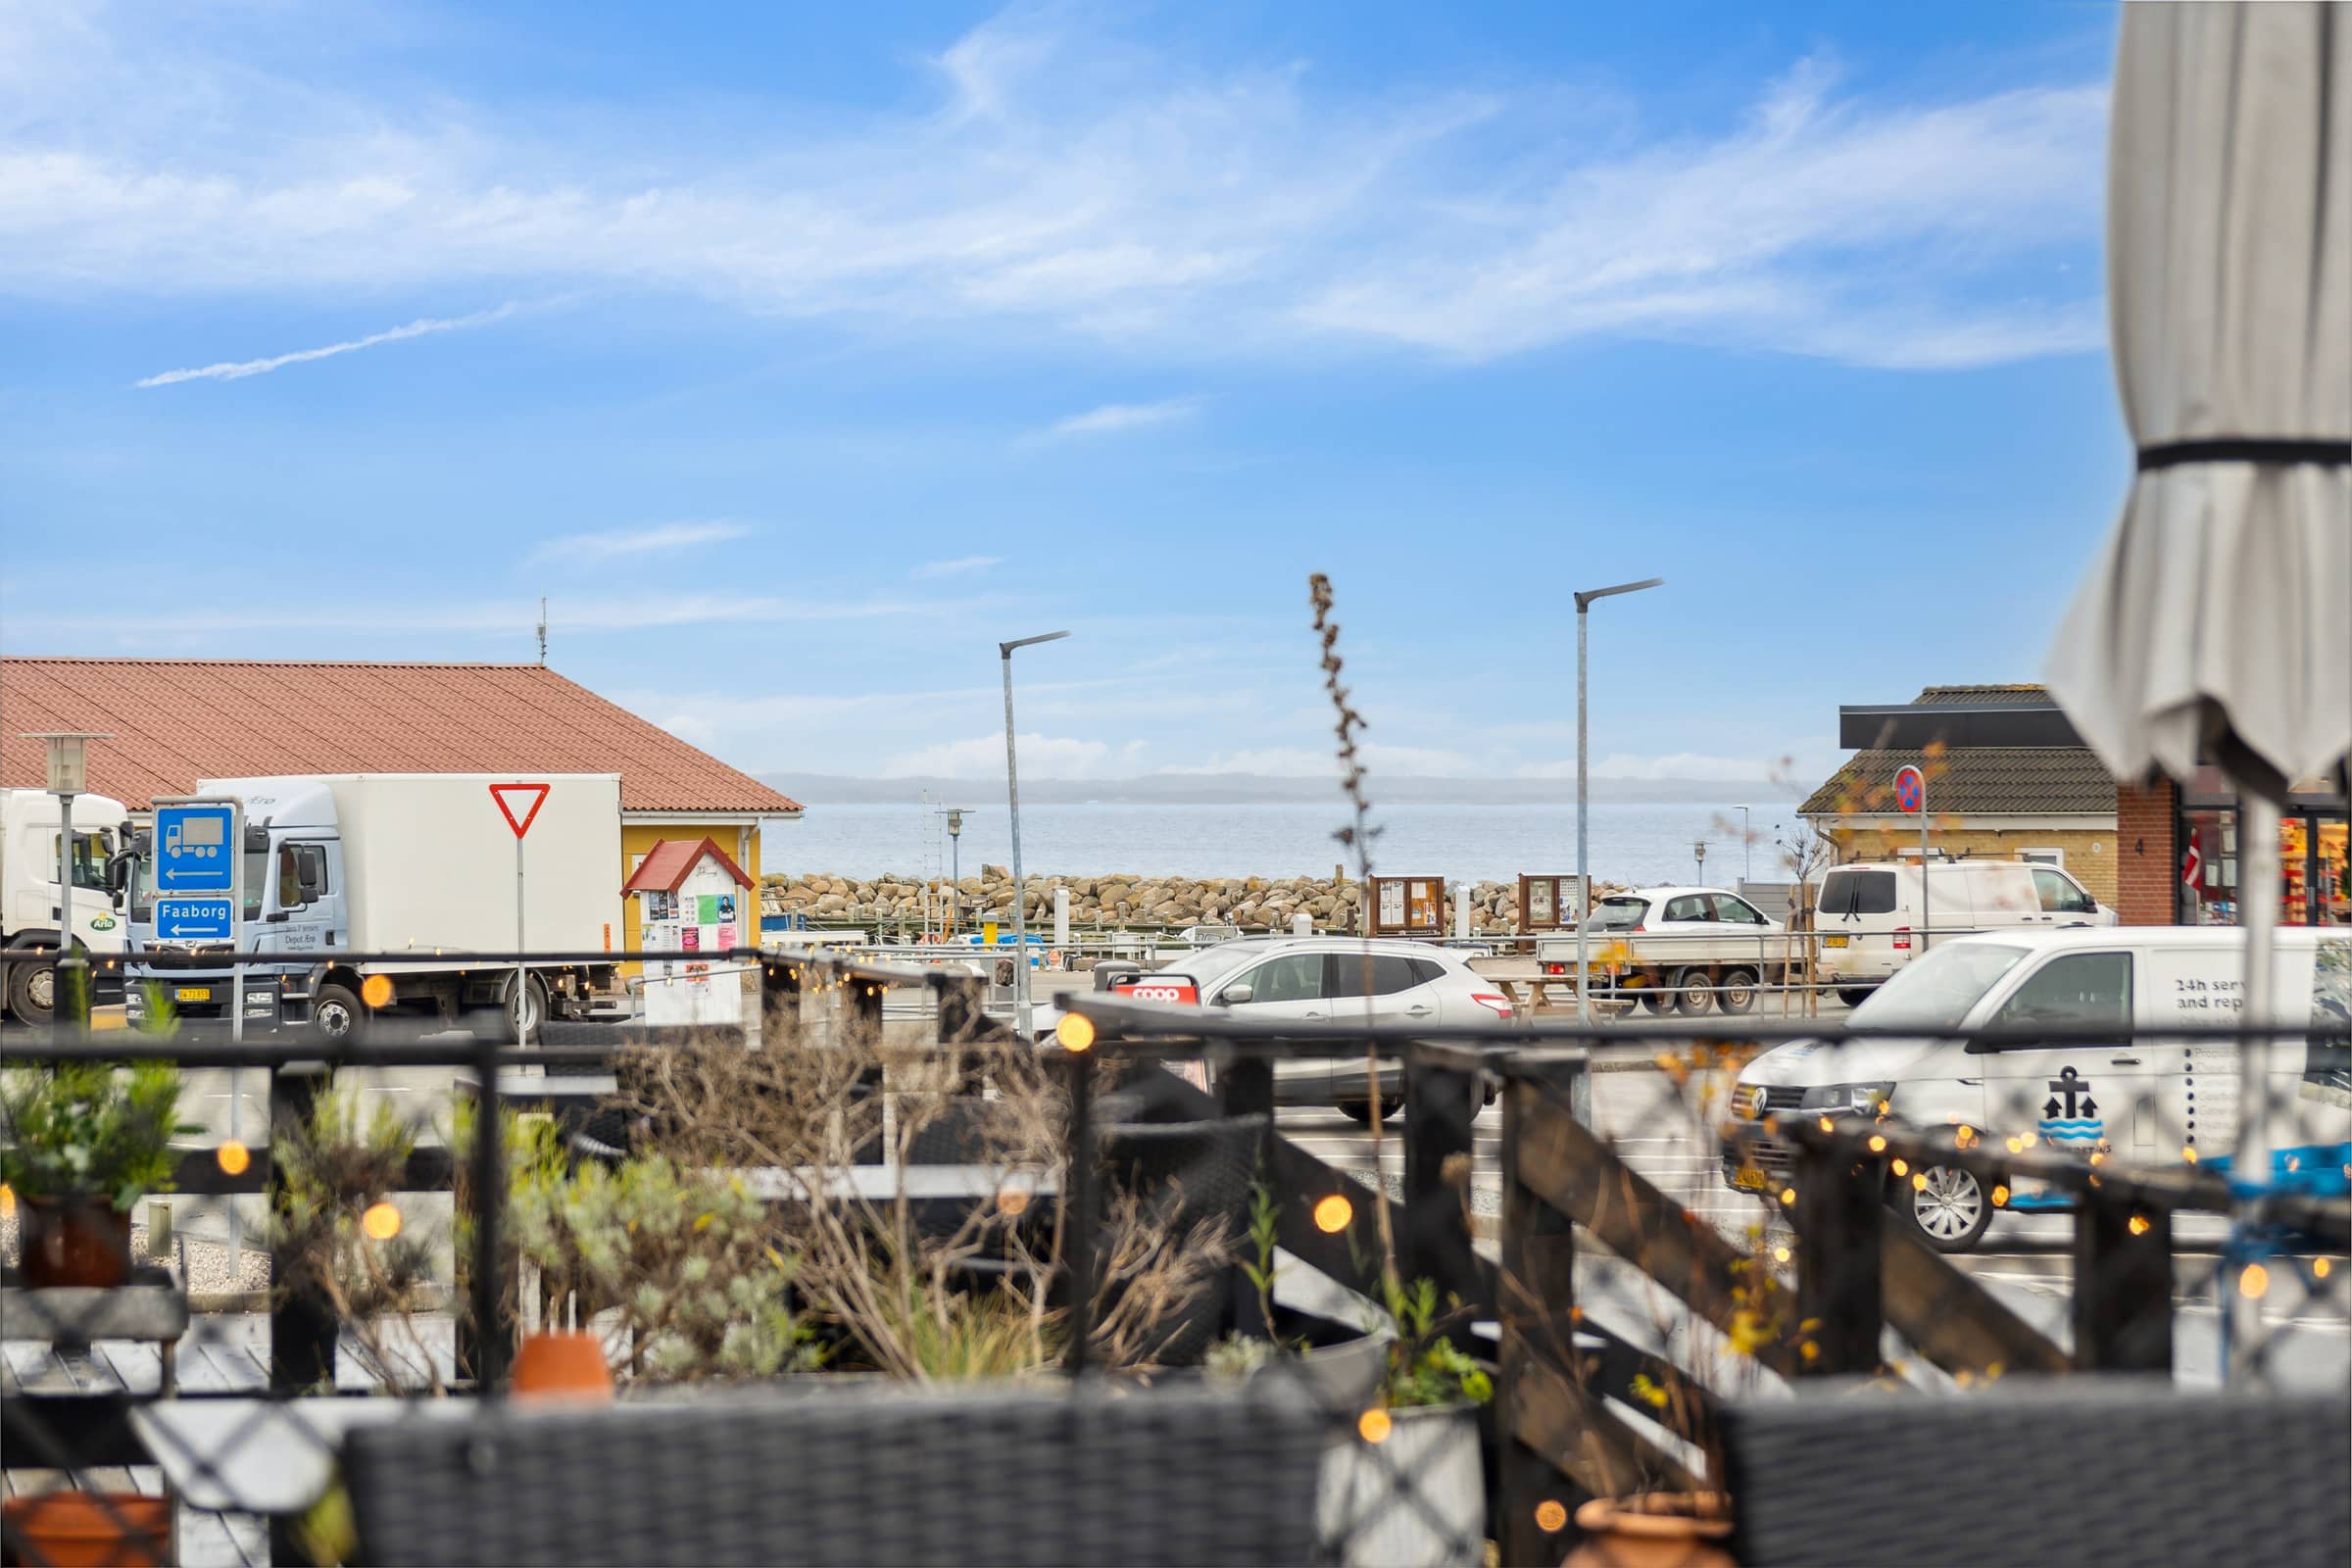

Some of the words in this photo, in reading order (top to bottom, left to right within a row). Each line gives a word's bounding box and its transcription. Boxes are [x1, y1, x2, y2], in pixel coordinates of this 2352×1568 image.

[2134, 838, 2144, 857] 4
[162, 905, 227, 920] Faaborg
[93, 919, 114, 928] Arla
[2176, 979, 2207, 992] 24h
[2178, 996, 2208, 1009] and
